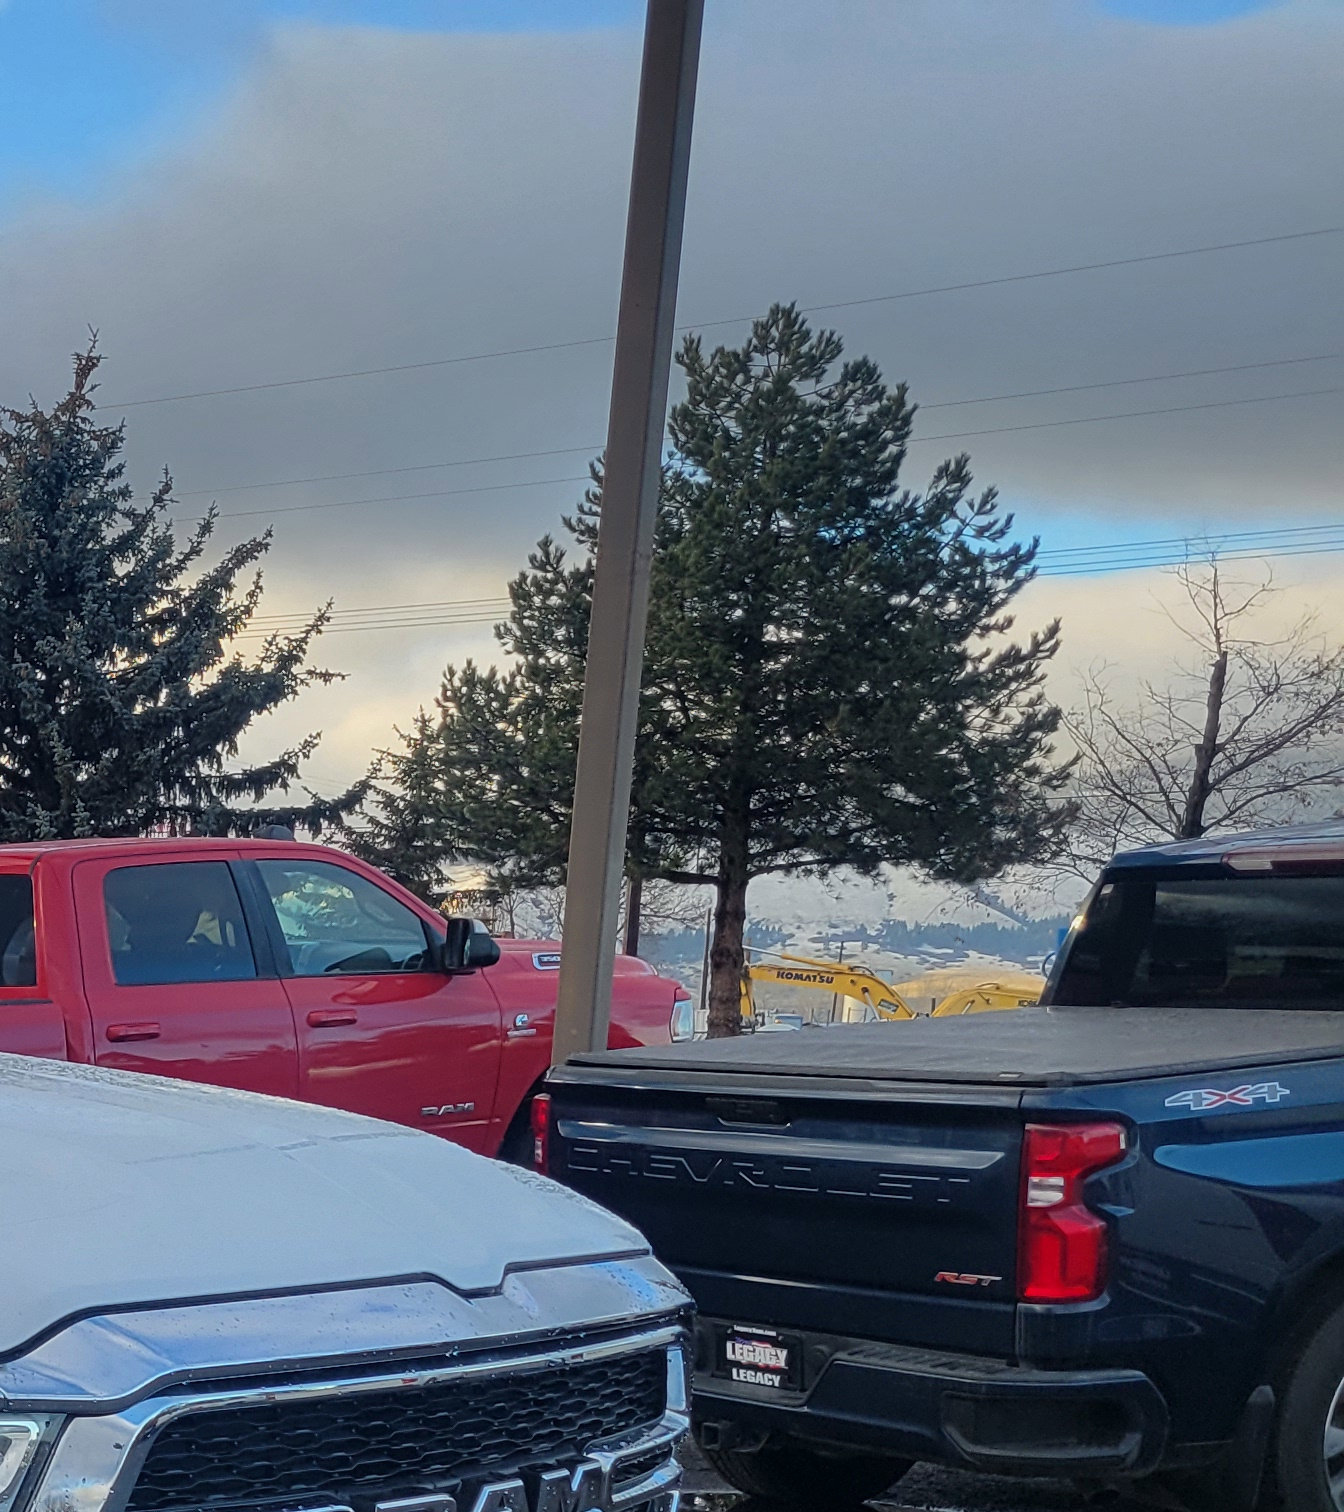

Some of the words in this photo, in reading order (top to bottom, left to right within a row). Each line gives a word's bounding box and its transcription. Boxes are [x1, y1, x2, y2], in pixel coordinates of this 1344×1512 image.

[775, 970, 834, 985] KOMATSU
[421, 1102, 475, 1117] RAM
[567, 1146, 971, 1202] CHEVROLET
[934, 1271, 1003, 1287] RST
[726, 1340, 788, 1367] LEGACY
[732, 1367, 781, 1387] LEGACY
